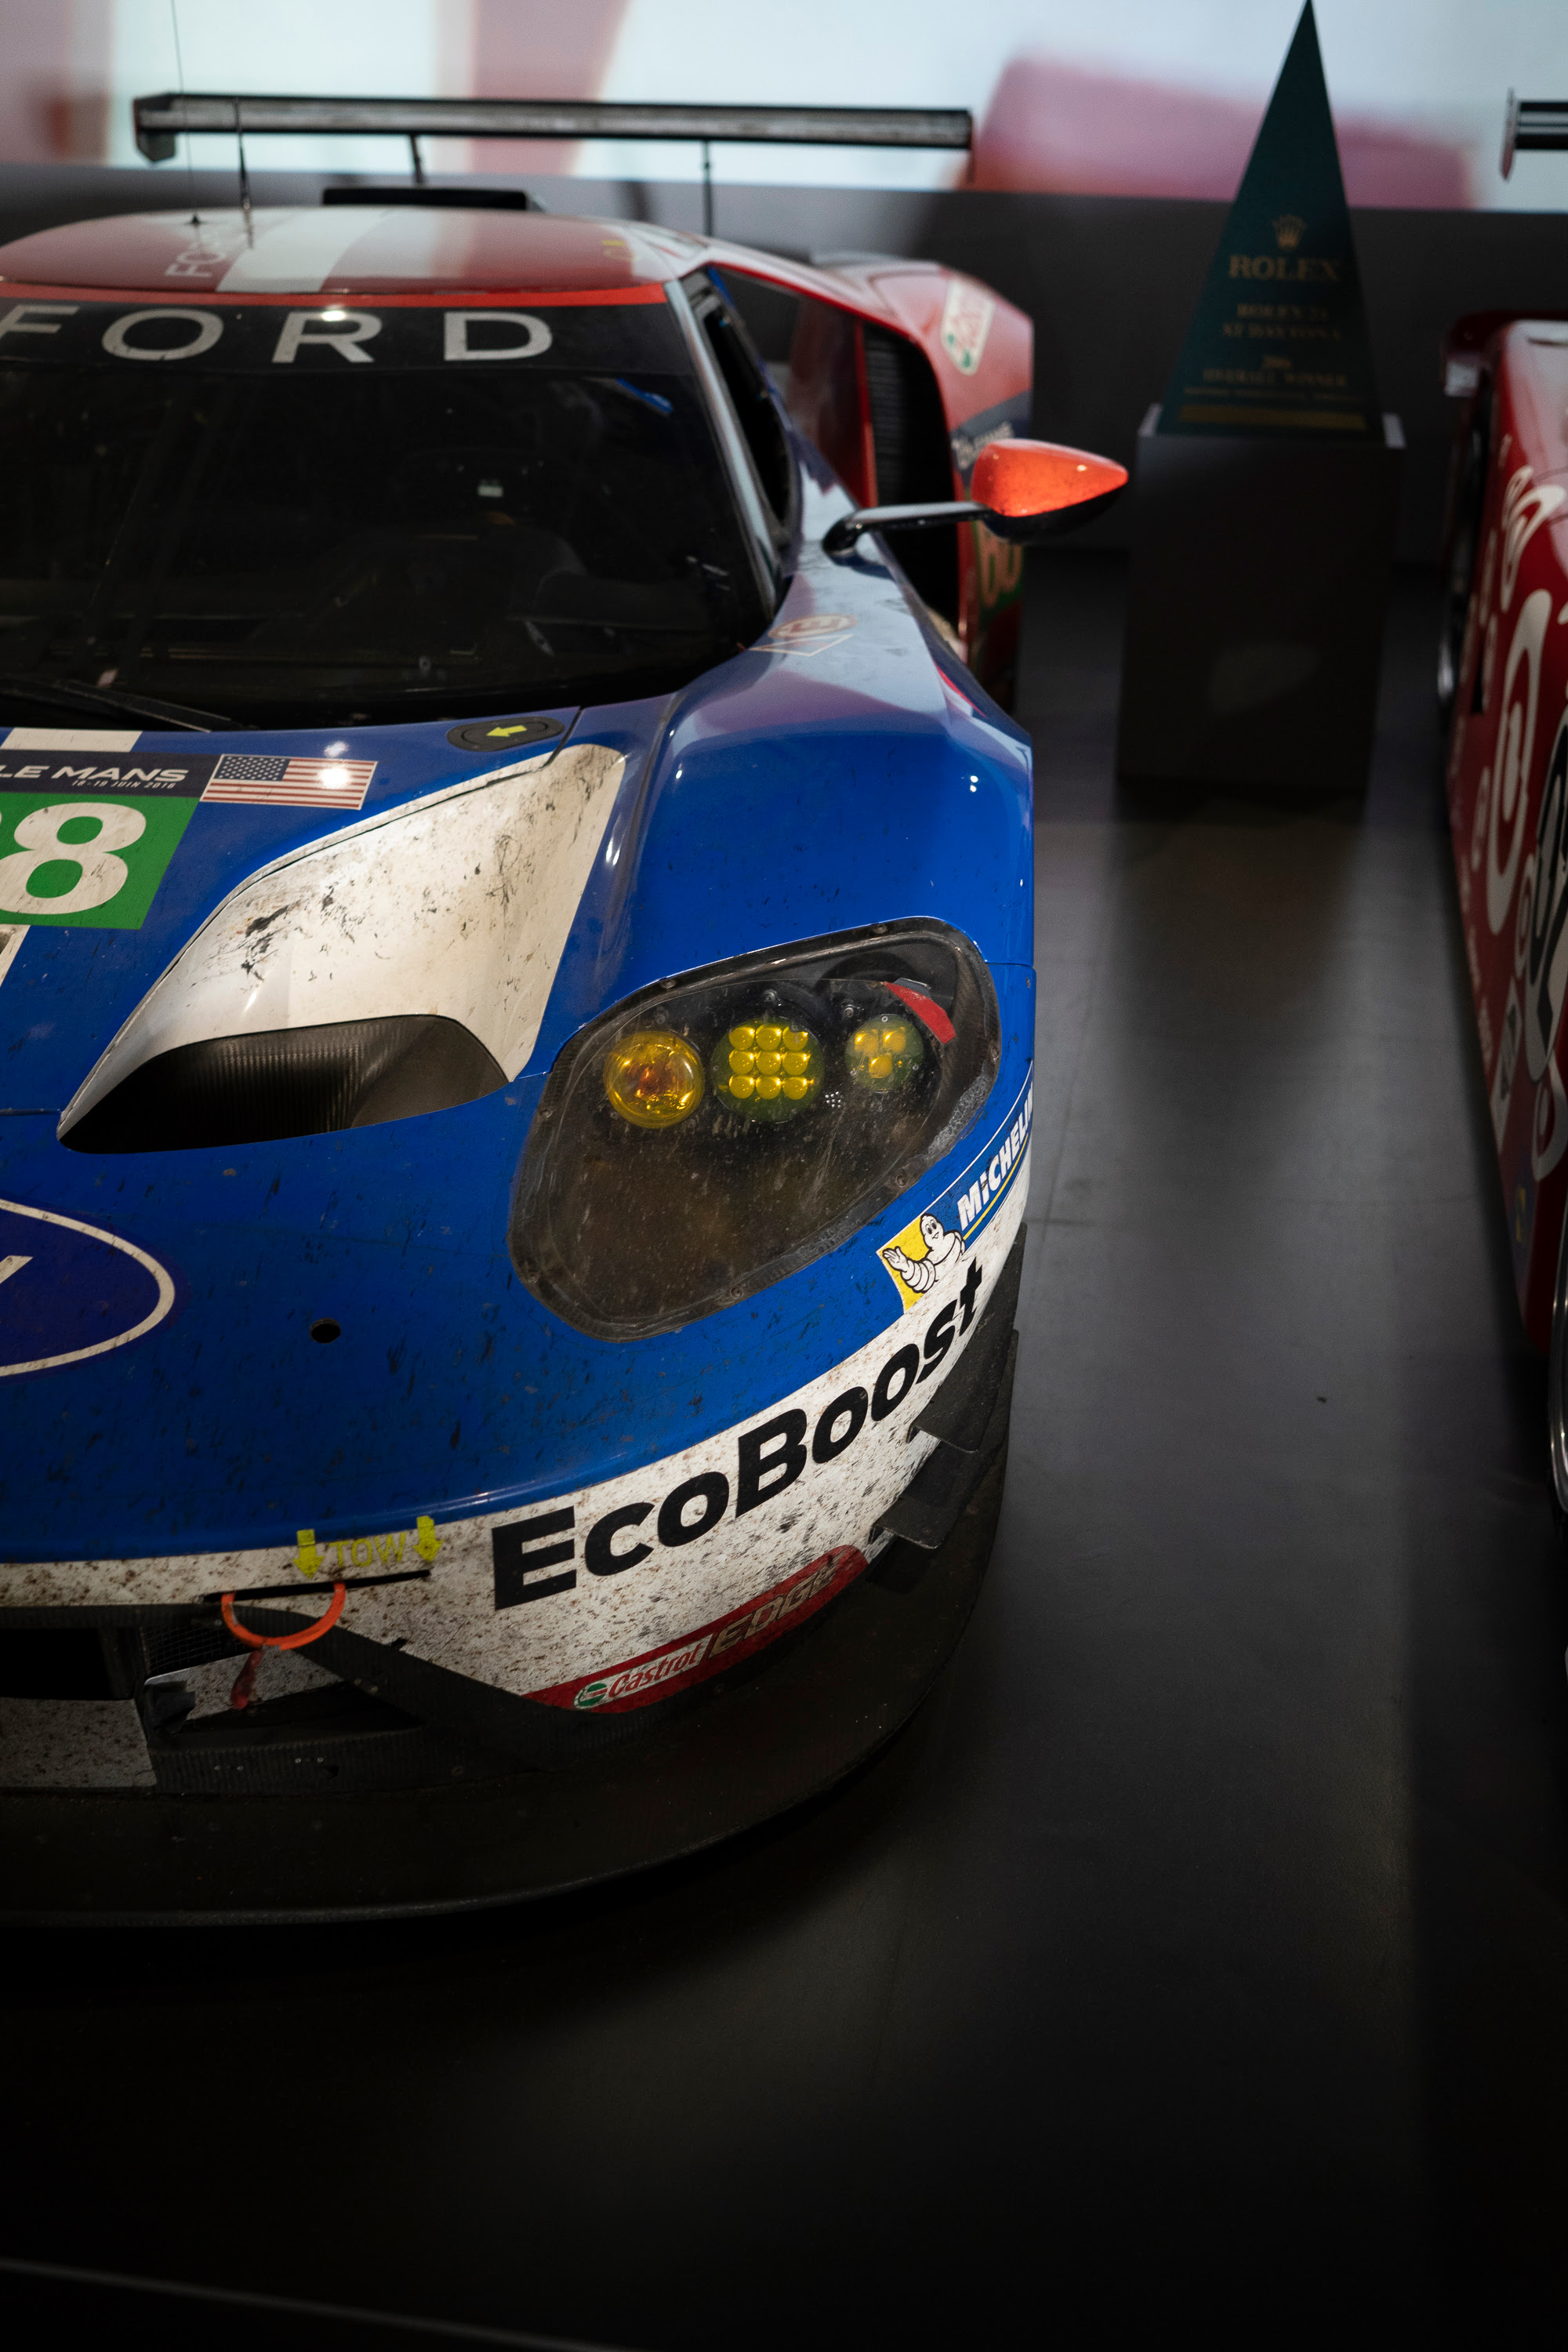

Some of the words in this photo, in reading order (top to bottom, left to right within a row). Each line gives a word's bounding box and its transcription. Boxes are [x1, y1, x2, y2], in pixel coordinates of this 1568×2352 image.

[1228, 255, 1340, 281] ROLEX
[0, 305, 553, 364] FORD
[51, 766, 189, 782] MANS
[0, 802, 147, 915] 8
[492, 1258, 983, 1610] EcoBoost
[328, 1531, 408, 1569] TOW
[608, 1643, 702, 1698] Castrol
[708, 1549, 848, 1659] EDGE
